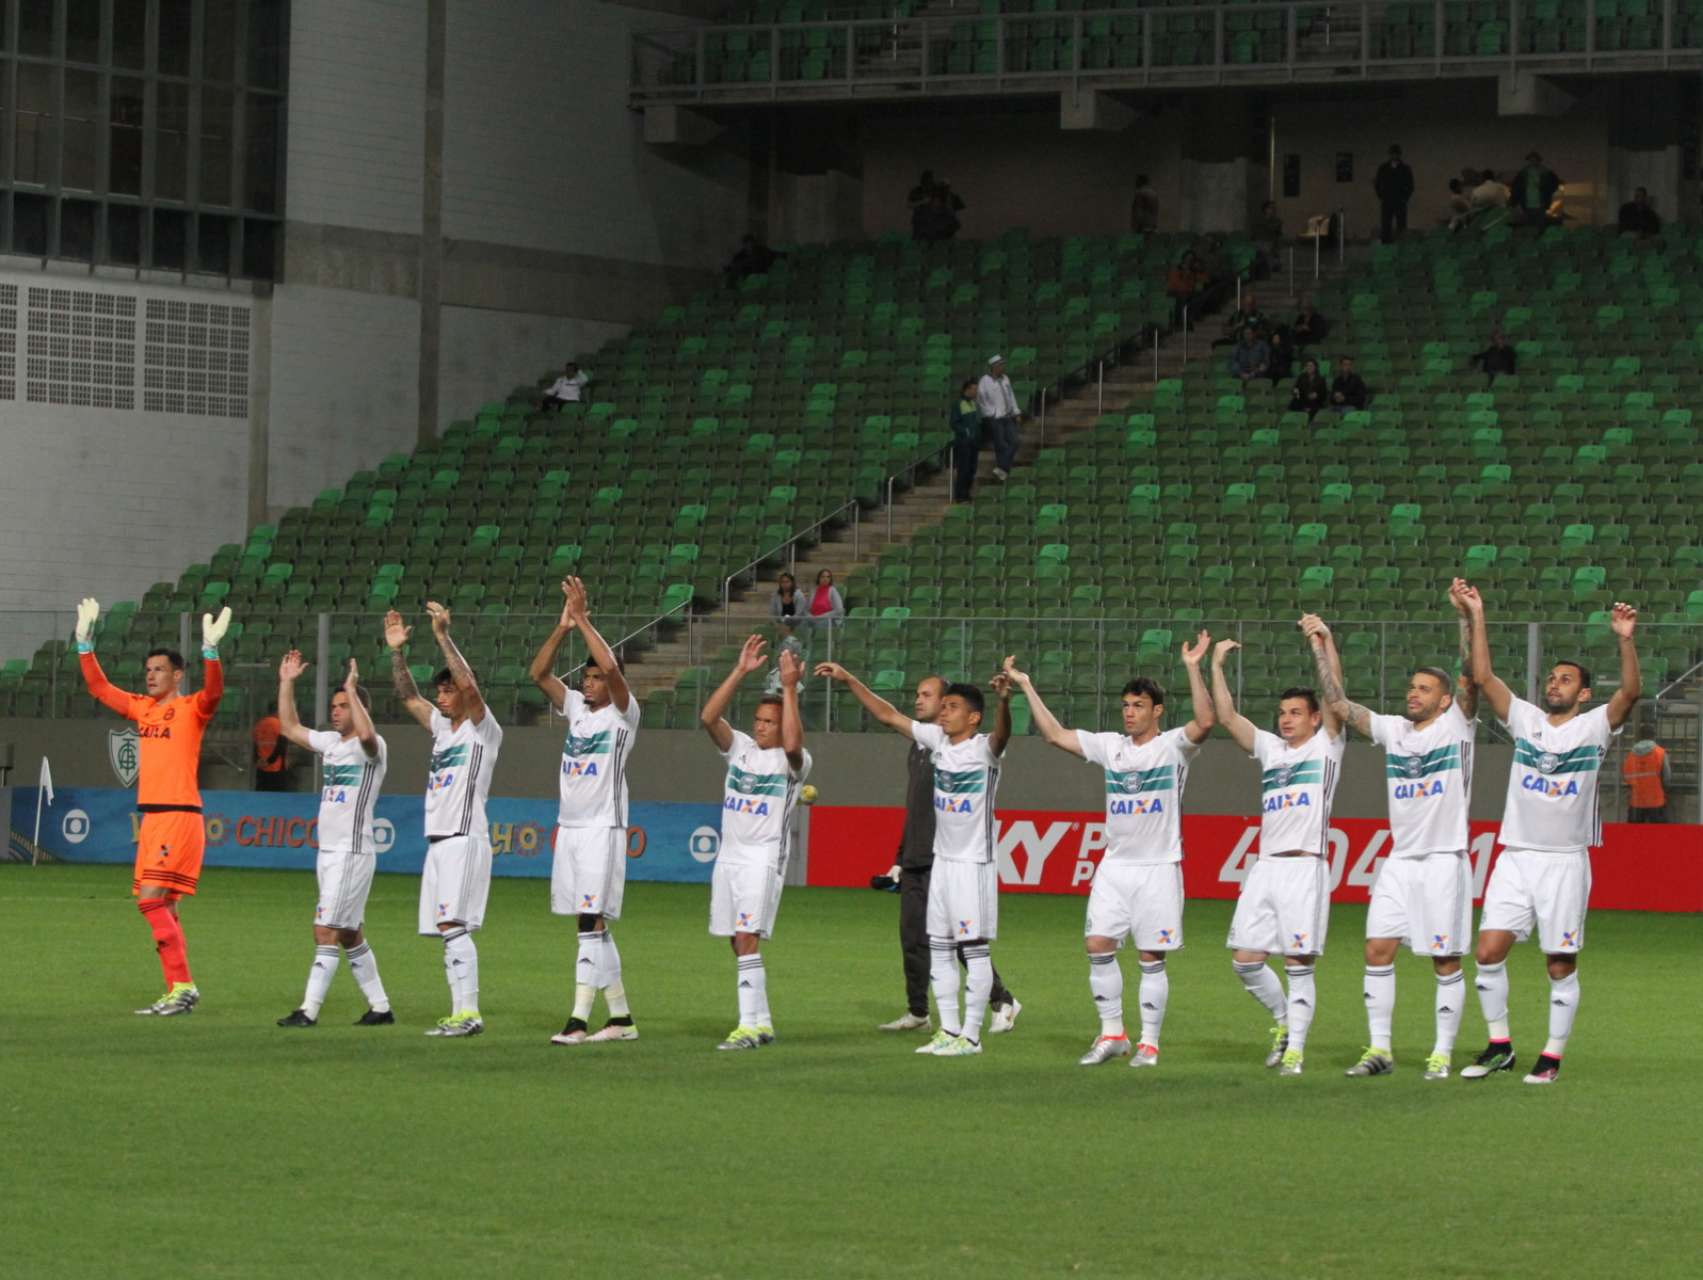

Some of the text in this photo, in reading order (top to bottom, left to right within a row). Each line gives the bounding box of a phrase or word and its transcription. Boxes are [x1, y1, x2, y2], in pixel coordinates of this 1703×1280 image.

[1395, 780, 1443, 799] CAIXA
[1522, 774, 1578, 797] CAIXA
[1111, 799, 1163, 815] CAIXA
[993, 819, 1072, 884] KY
